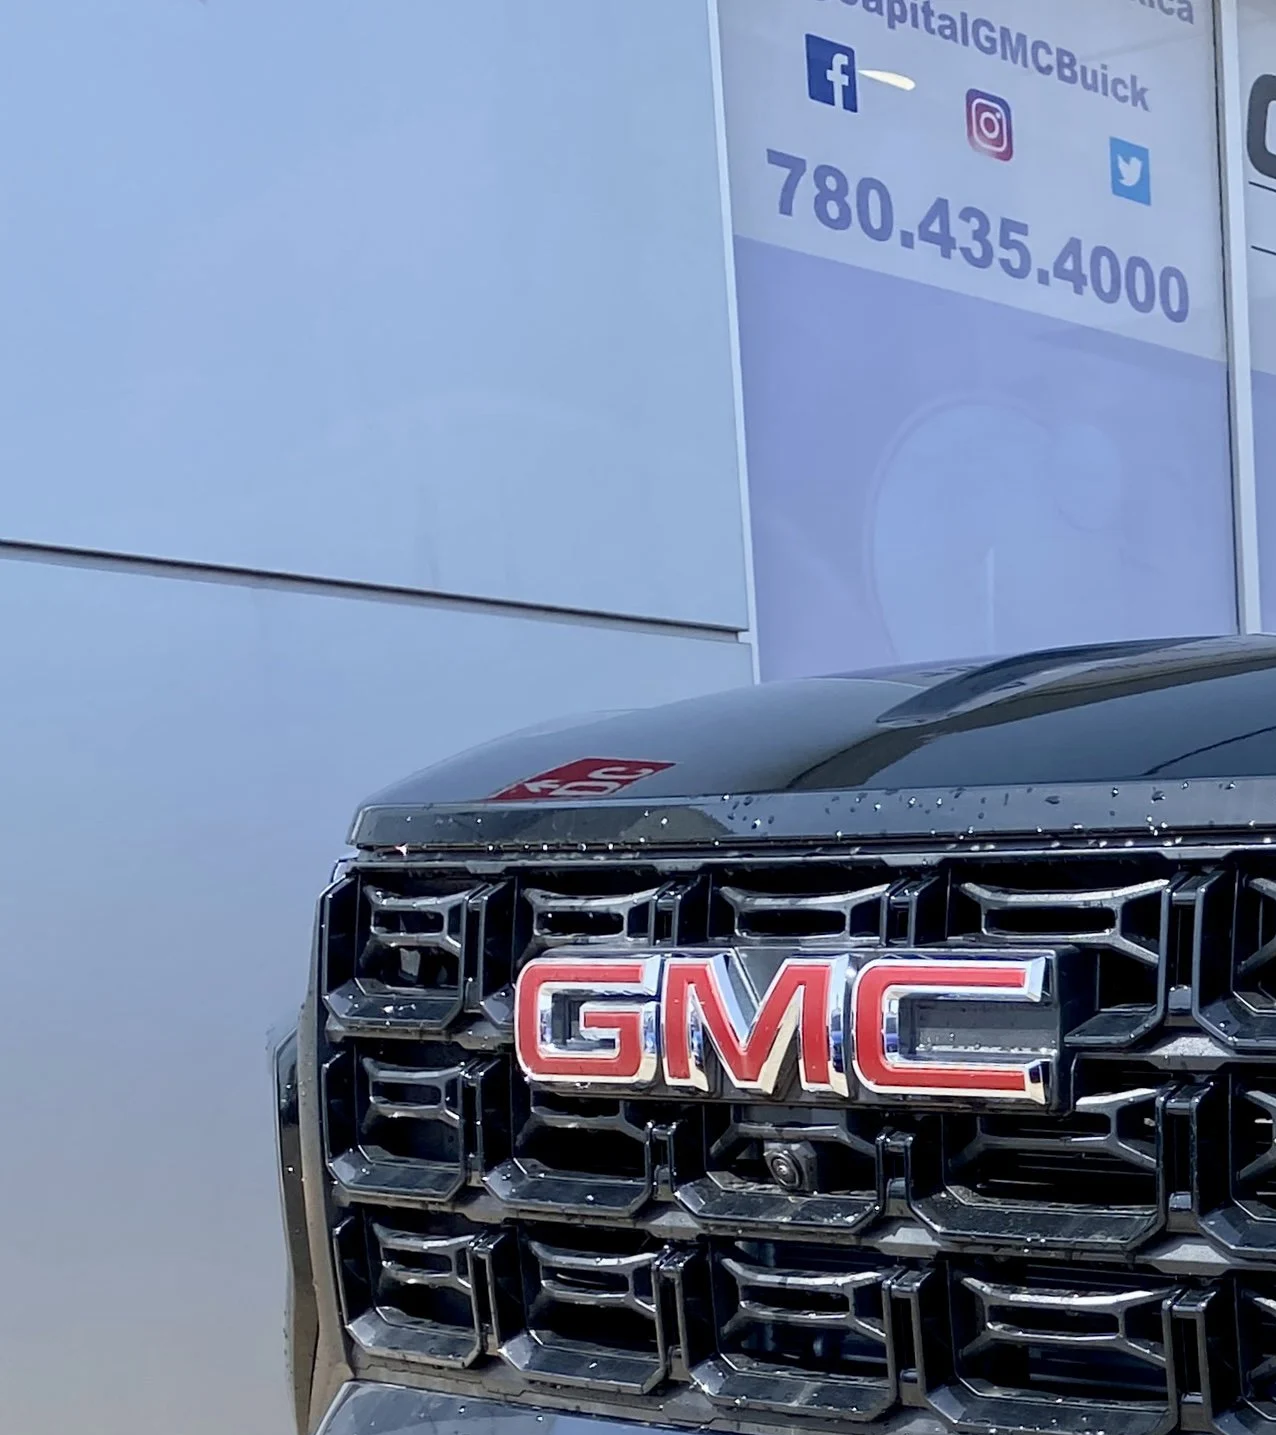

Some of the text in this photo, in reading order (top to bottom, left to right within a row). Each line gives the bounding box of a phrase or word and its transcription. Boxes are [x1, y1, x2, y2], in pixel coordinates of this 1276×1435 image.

[841, 0, 1150, 111] apitalGMCBuick
[766, 148, 1190, 323] 780.435.4000
[515, 954, 1053, 1104] GMC
